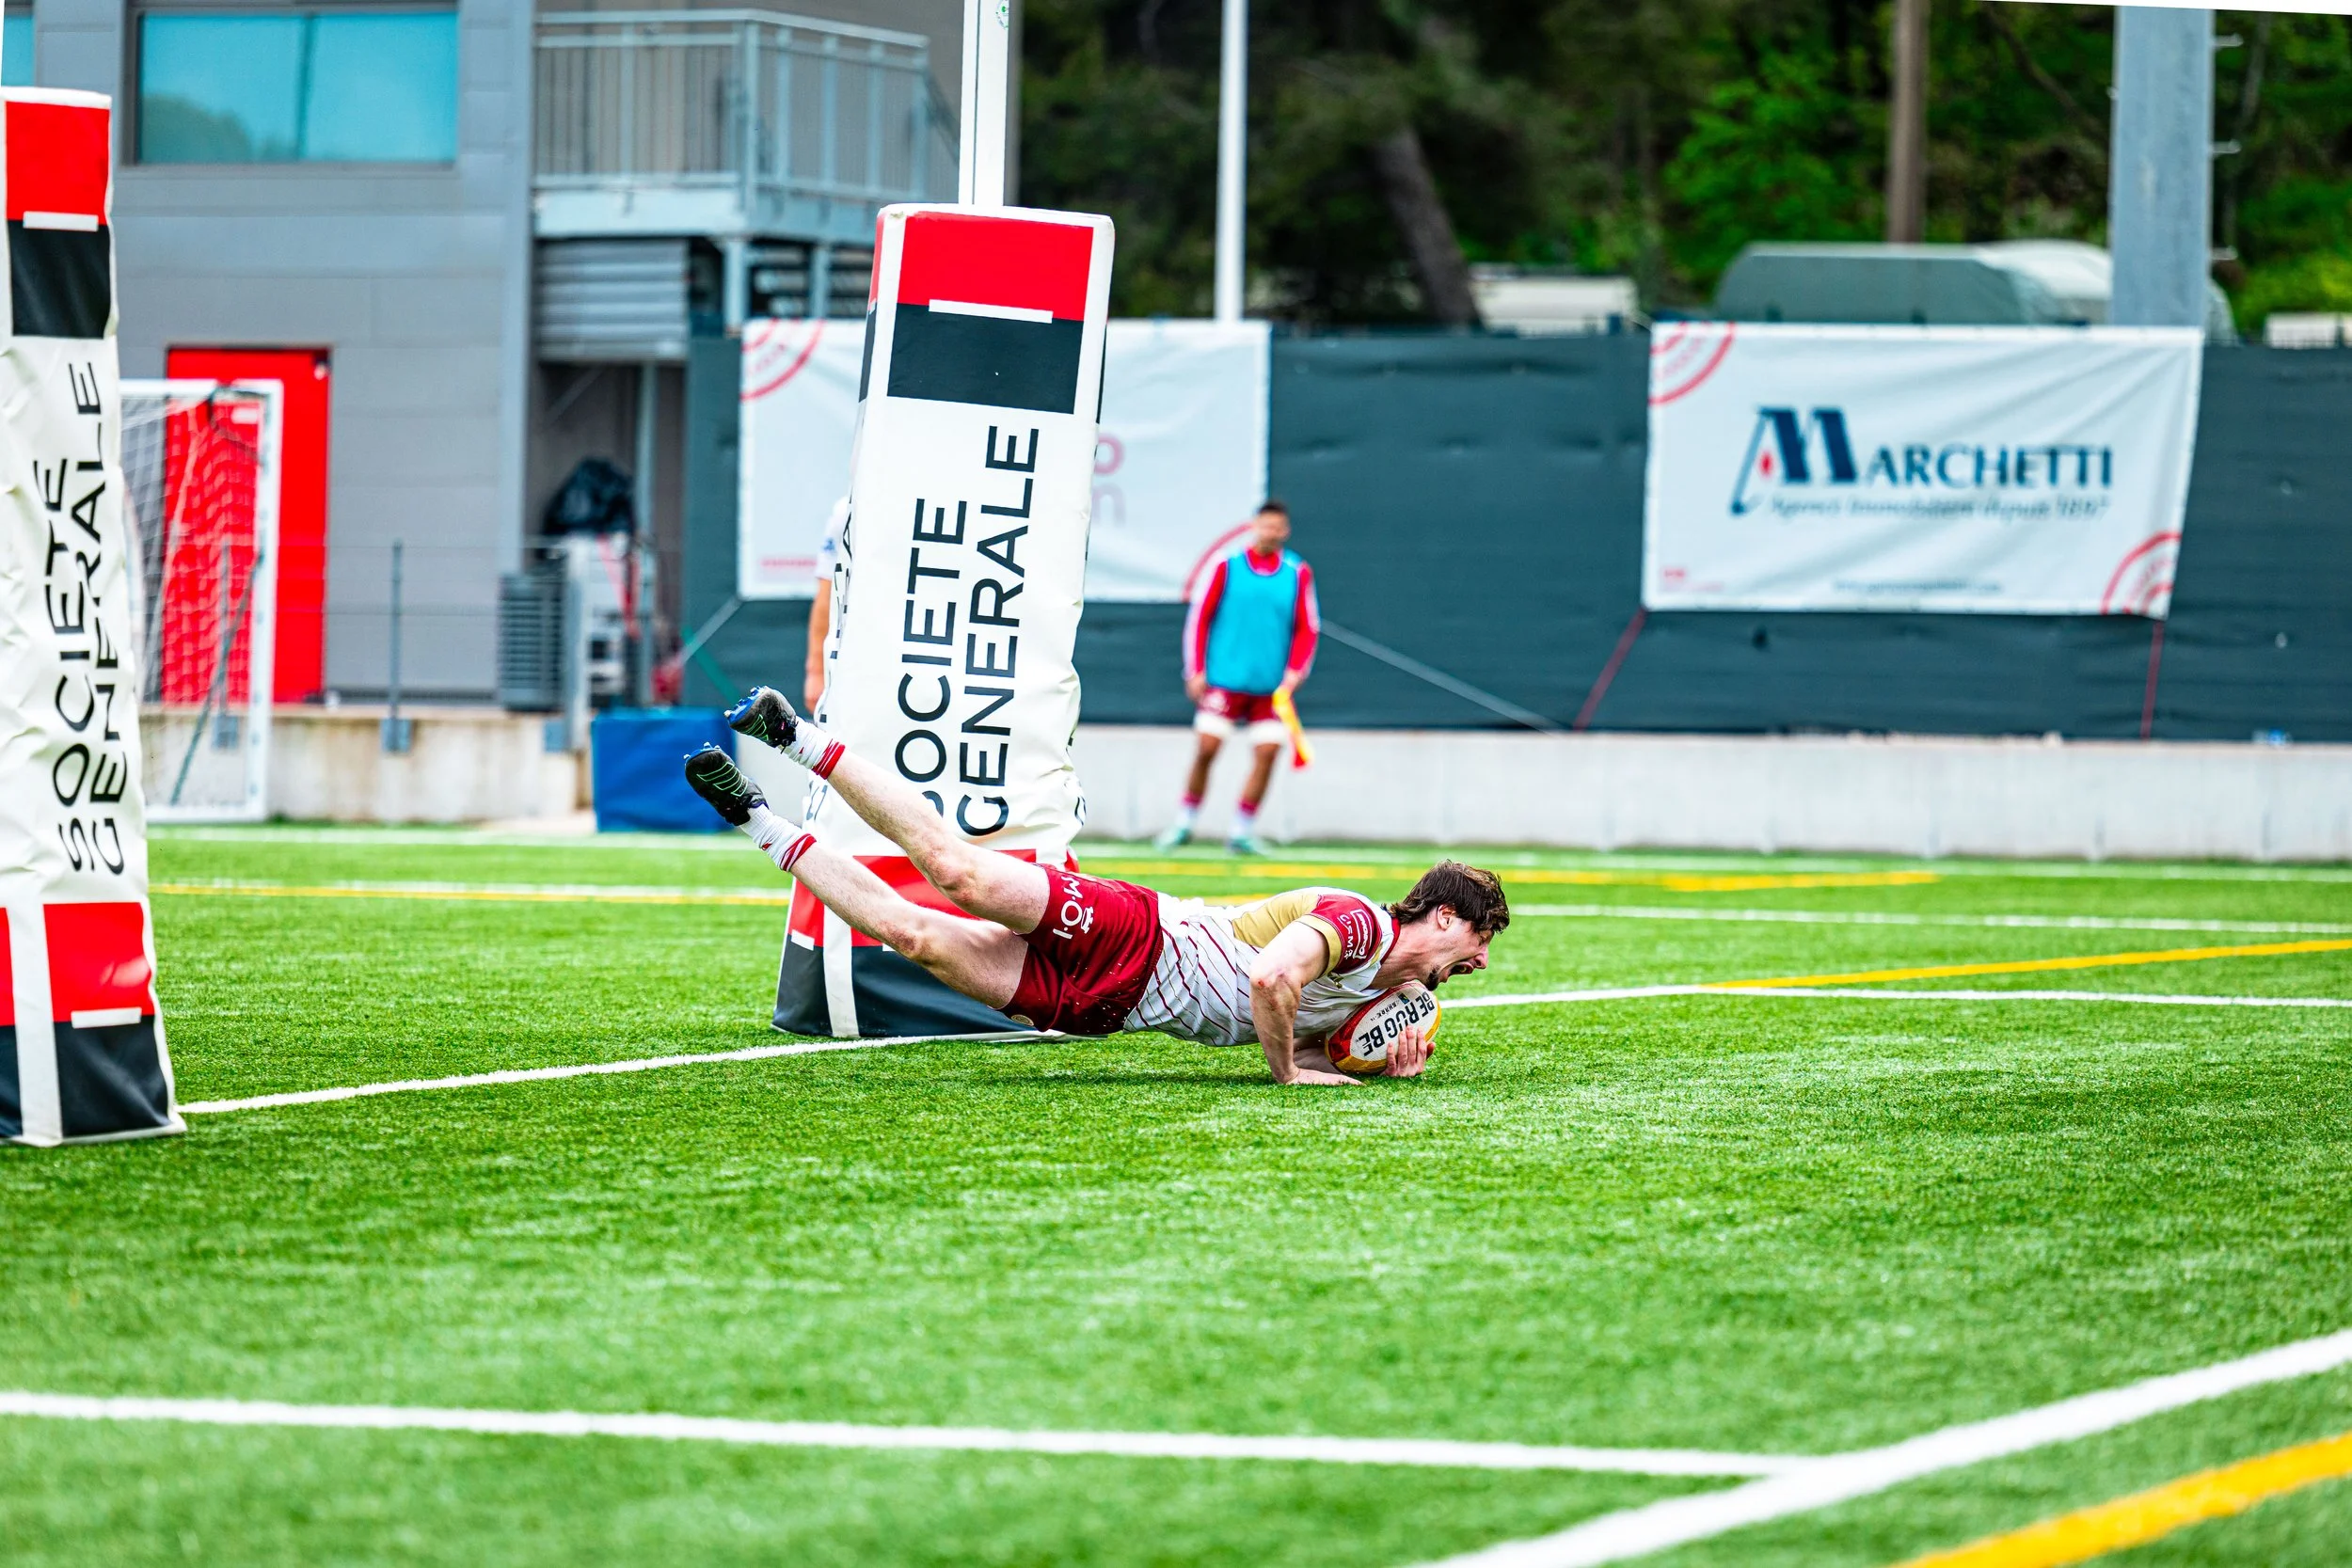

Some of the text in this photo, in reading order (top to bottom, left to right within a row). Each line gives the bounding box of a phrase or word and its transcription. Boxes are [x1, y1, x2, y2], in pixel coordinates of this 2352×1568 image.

[34, 457, 94, 871] SOCIETE
[957, 425, 1040, 836] GENERALE
[1729, 406, 2113, 516] MARCHETTI
